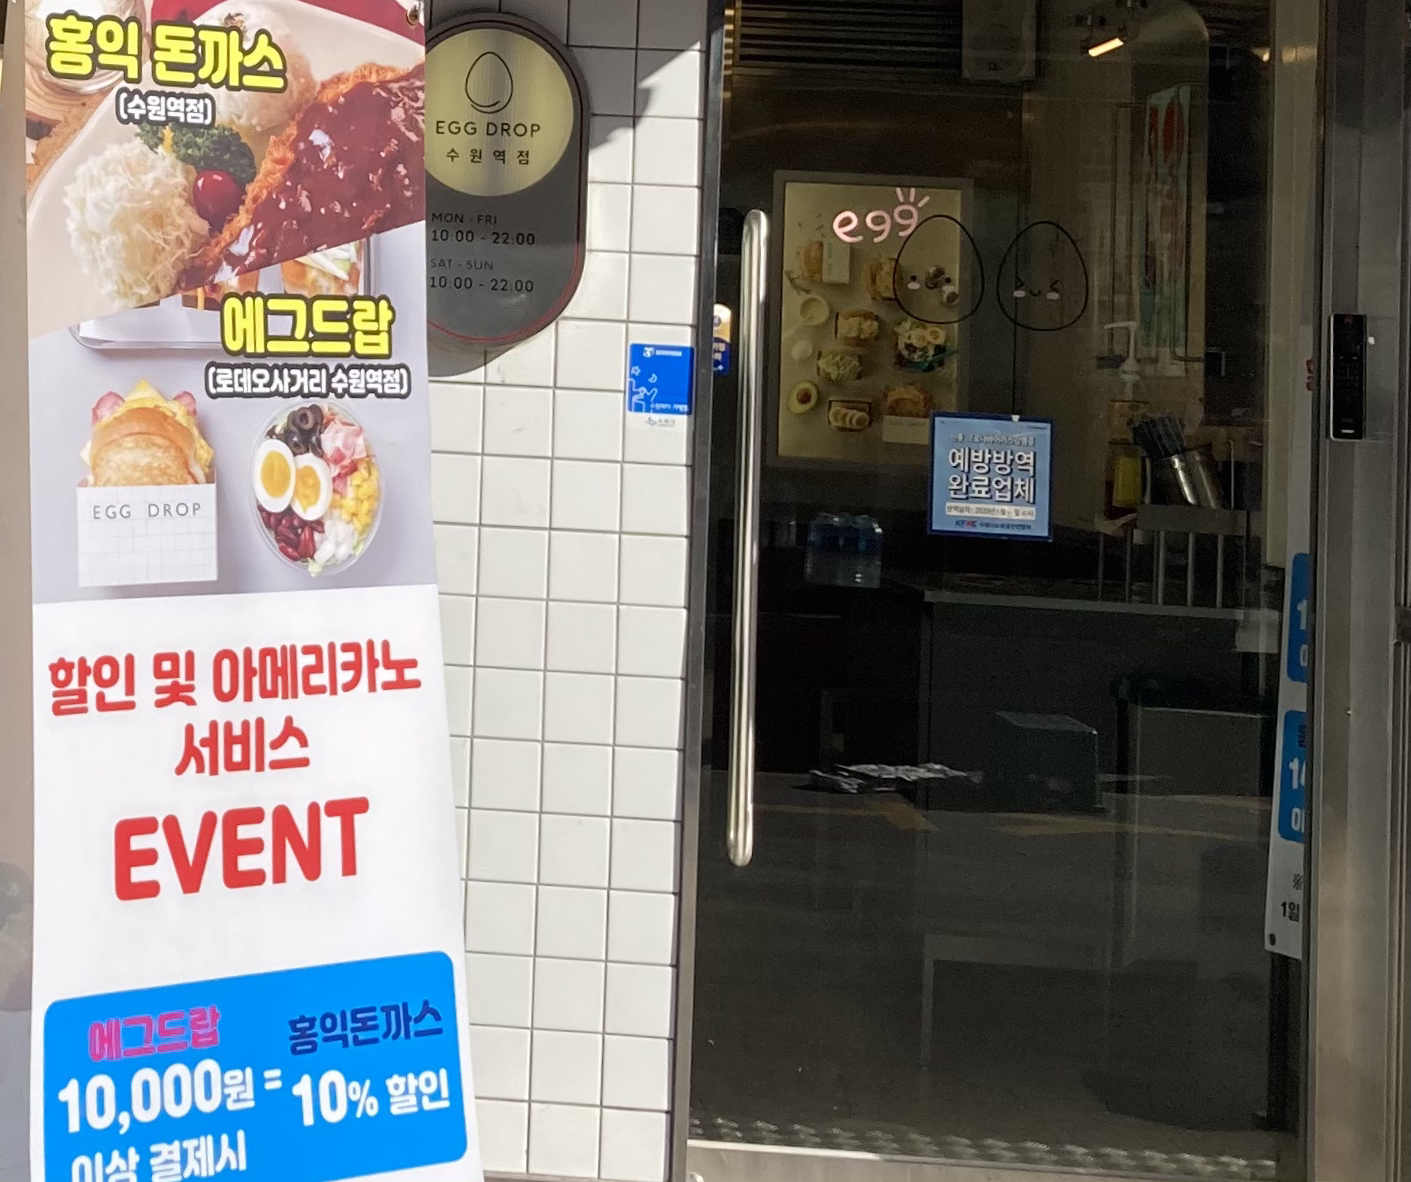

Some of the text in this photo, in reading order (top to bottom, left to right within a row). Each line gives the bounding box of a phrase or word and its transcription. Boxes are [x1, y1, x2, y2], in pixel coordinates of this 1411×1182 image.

[48, 14, 286, 89] 홍익 돈까스
[118, 91, 213, 126] (수원역점)
[435, 121, 541, 138] EGG DROP
[431, 213, 465, 224] MON
[477, 215, 497, 226] FRI
[432, 229, 475, 243] 10:00
[492, 231, 536, 246] 22:00
[430, 258, 453, 269] SAT
[466, 260, 494, 271] SUN
[430, 276, 473, 290] 10:00
[490, 278, 535, 293] 22:00
[223, 296, 394, 355] 에그드랍
[208, 367, 409, 395] (로데오사거리 수원역점)
[948, 447, 1036, 478] 예방방역
[948, 474, 1036, 505] 완료업체
[93, 502, 201, 519] EGG DROP
[48, 639, 422, 716] 할인 및 아메리카노
[174, 715, 310, 776] 서비스
[113, 796, 370, 901] EVENT
[89, 1005, 221, 1061] 에그드랍
[288, 999, 443, 1056] 홍익돈까스
[58, 1058, 255, 1135] 10,000원
[292, 1069, 379, 1126] 10%
[386, 1067, 450, 1115] 할인
[71, 1129, 247, 1182] 이상 결제시
